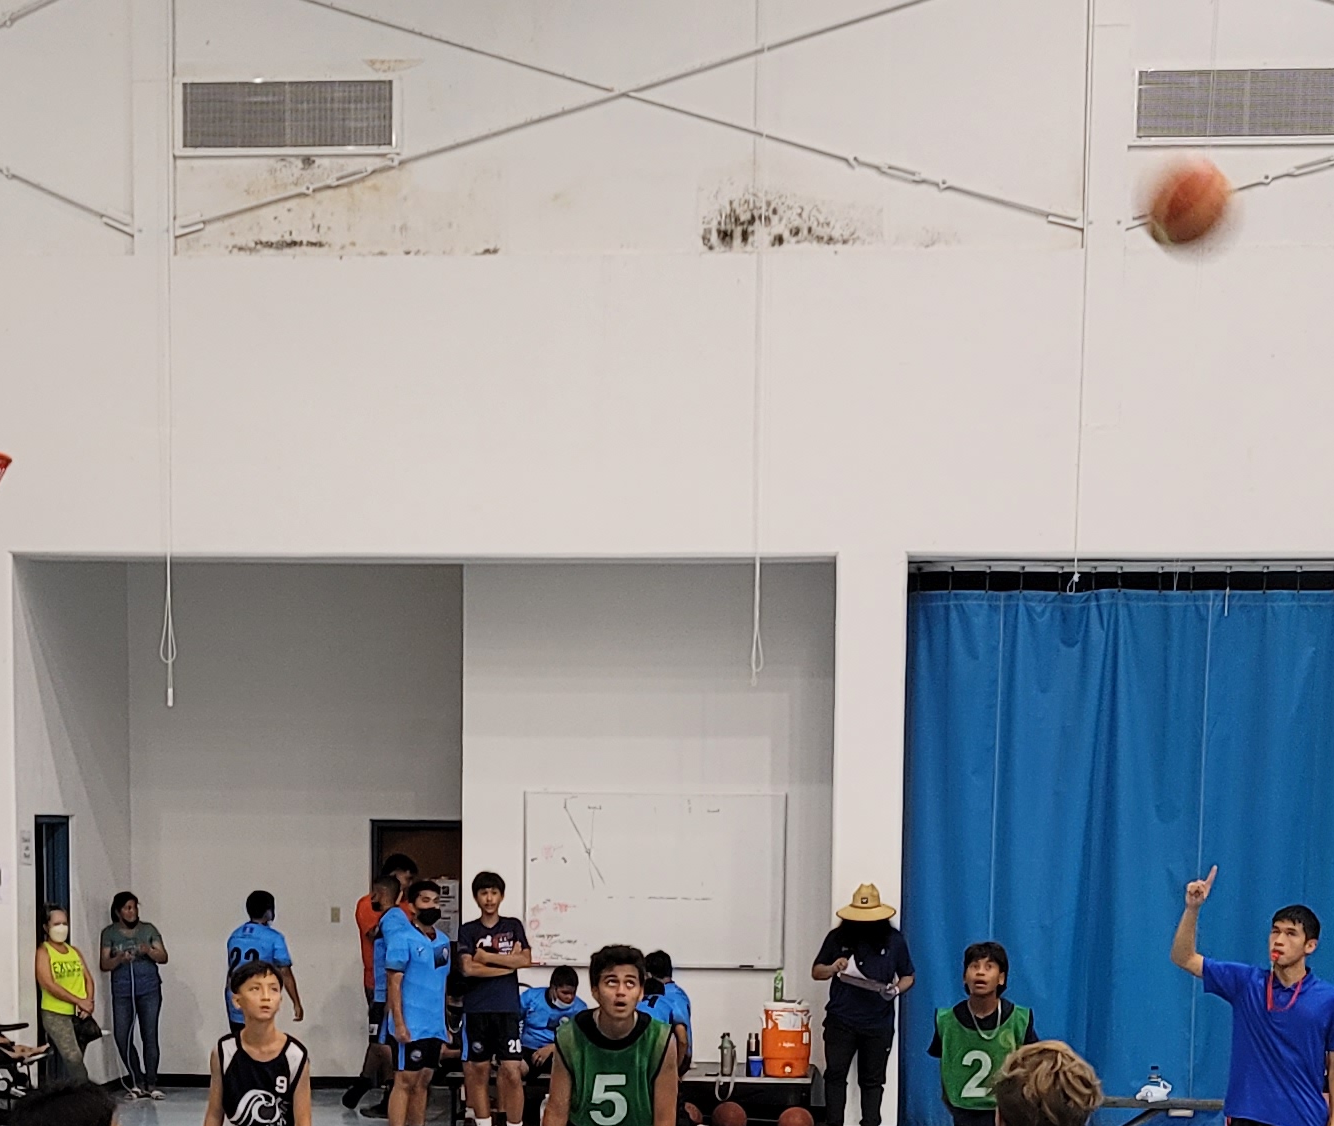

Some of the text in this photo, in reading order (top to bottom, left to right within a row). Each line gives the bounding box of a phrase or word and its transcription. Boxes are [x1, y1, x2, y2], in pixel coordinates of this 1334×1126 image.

[274, 1076, 287, 1093] 9
[961, 1050, 993, 1098] 2
[589, 1074, 627, 1126] 5
